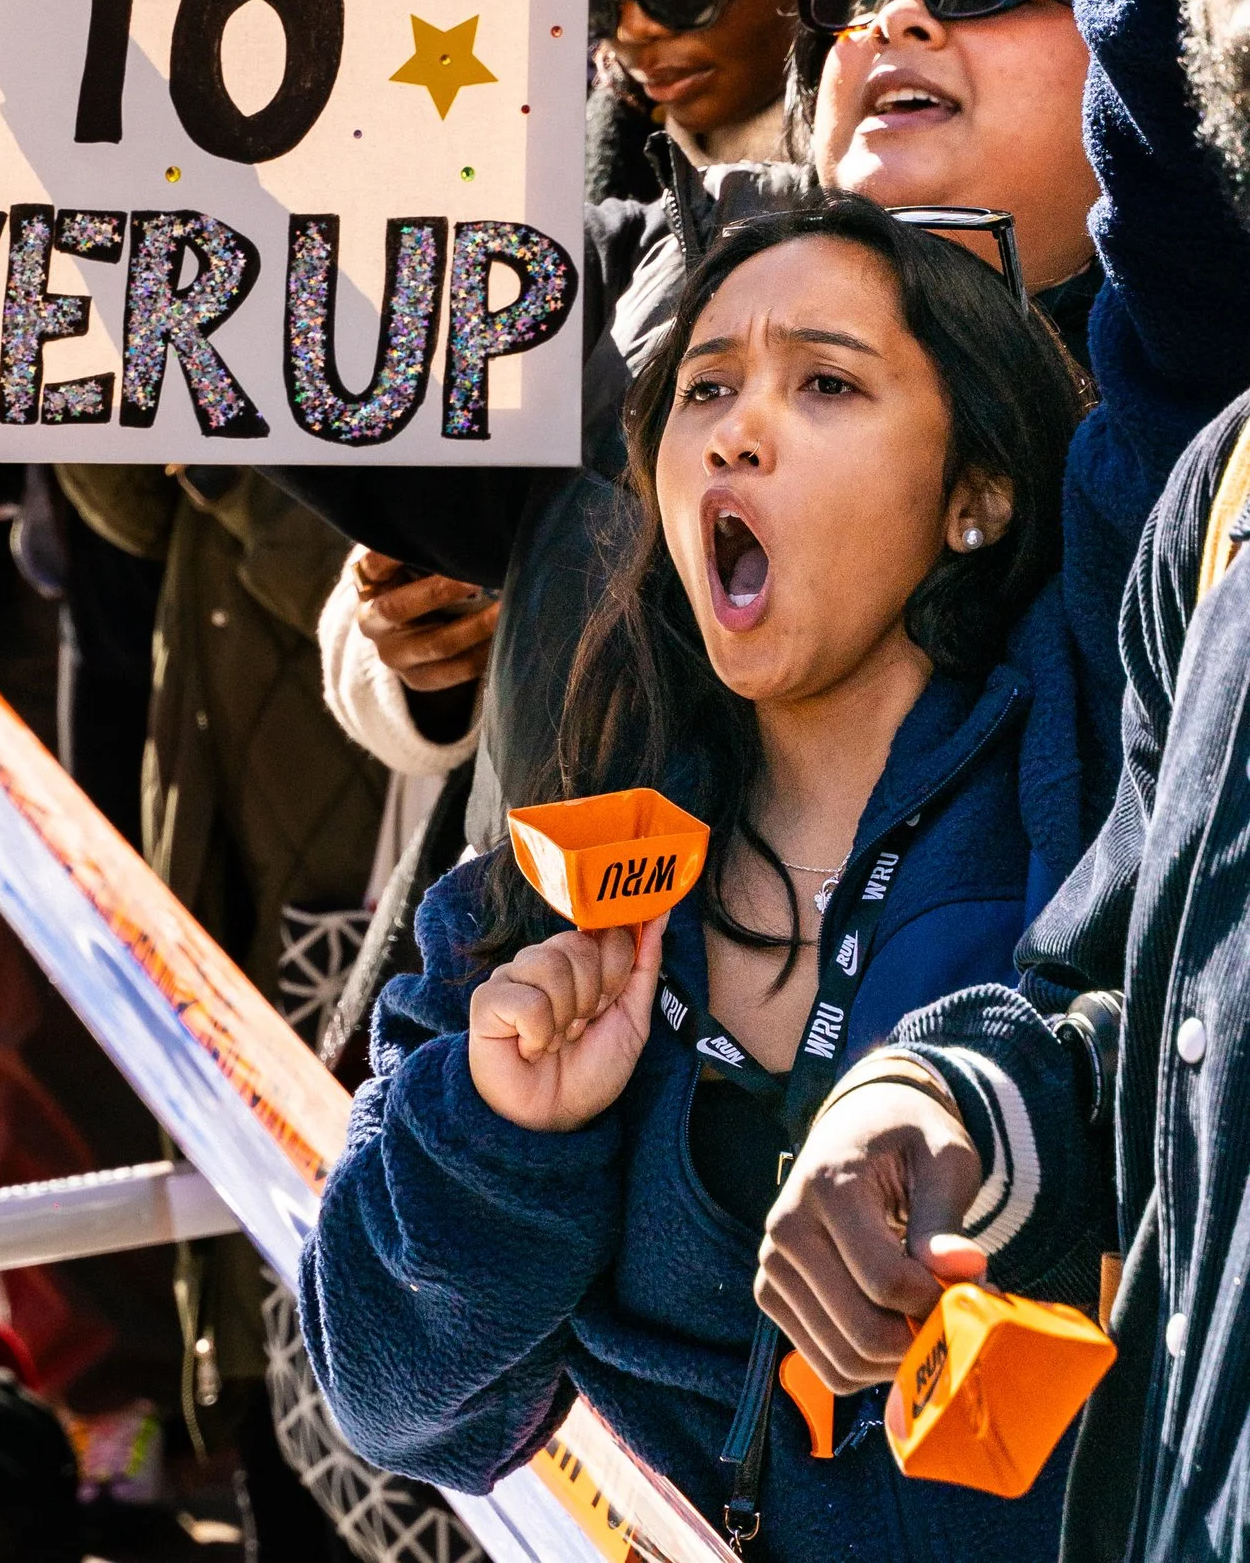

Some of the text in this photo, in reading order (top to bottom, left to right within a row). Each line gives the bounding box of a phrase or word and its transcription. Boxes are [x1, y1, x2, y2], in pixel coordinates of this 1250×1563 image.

[597, 855, 677, 902] WRU
[862, 852, 899, 900] WRU
[835, 934, 856, 968] RUN
[661, 986, 689, 1031] WRU
[804, 1002, 845, 1059] WRU
[710, 1035, 746, 1064] RUN
[916, 1332, 949, 1393] RUN
